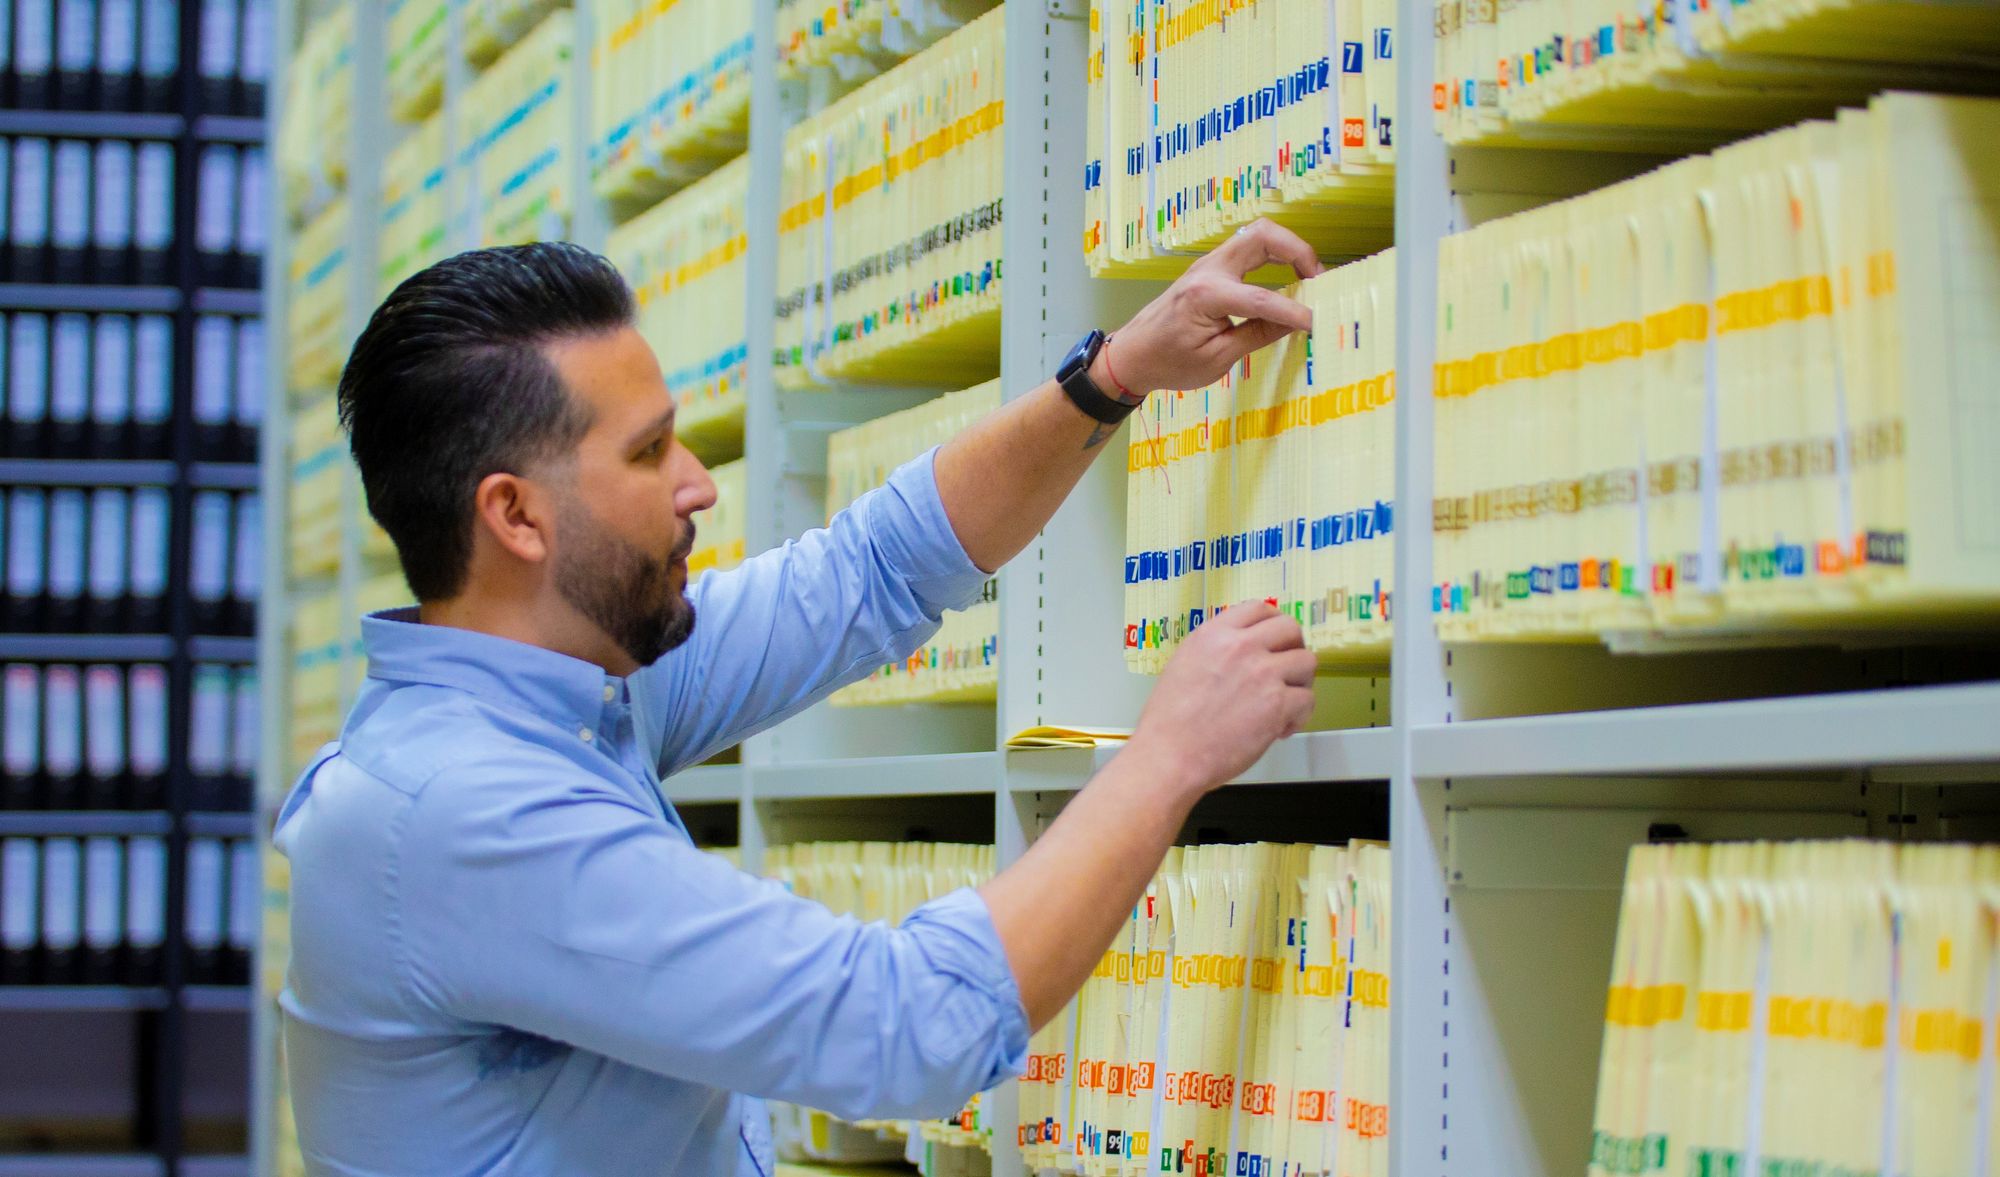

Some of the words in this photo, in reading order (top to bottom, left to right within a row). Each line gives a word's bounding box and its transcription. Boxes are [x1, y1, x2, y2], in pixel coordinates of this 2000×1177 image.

[1345, 44, 1357, 71] 7
[1263, 89, 1274, 114] 7
[1344, 123, 1363, 139] 98
[1363, 510, 1374, 538] 7
[1195, 544, 1204, 567] 7
[1119, 956, 1127, 979] 0
[1137, 959, 1146, 981] 0
[1151, 953, 1161, 975] 0
[1029, 1057, 1038, 1079] 8
[1139, 1063, 1150, 1087] 8
[1110, 1069, 1118, 1091] 8
[1166, 1075, 1175, 1099] 8
[1253, 1087, 1264, 1112] 8
[1108, 1135, 1121, 1149] 99
[1135, 1137, 1146, 1150] 10
